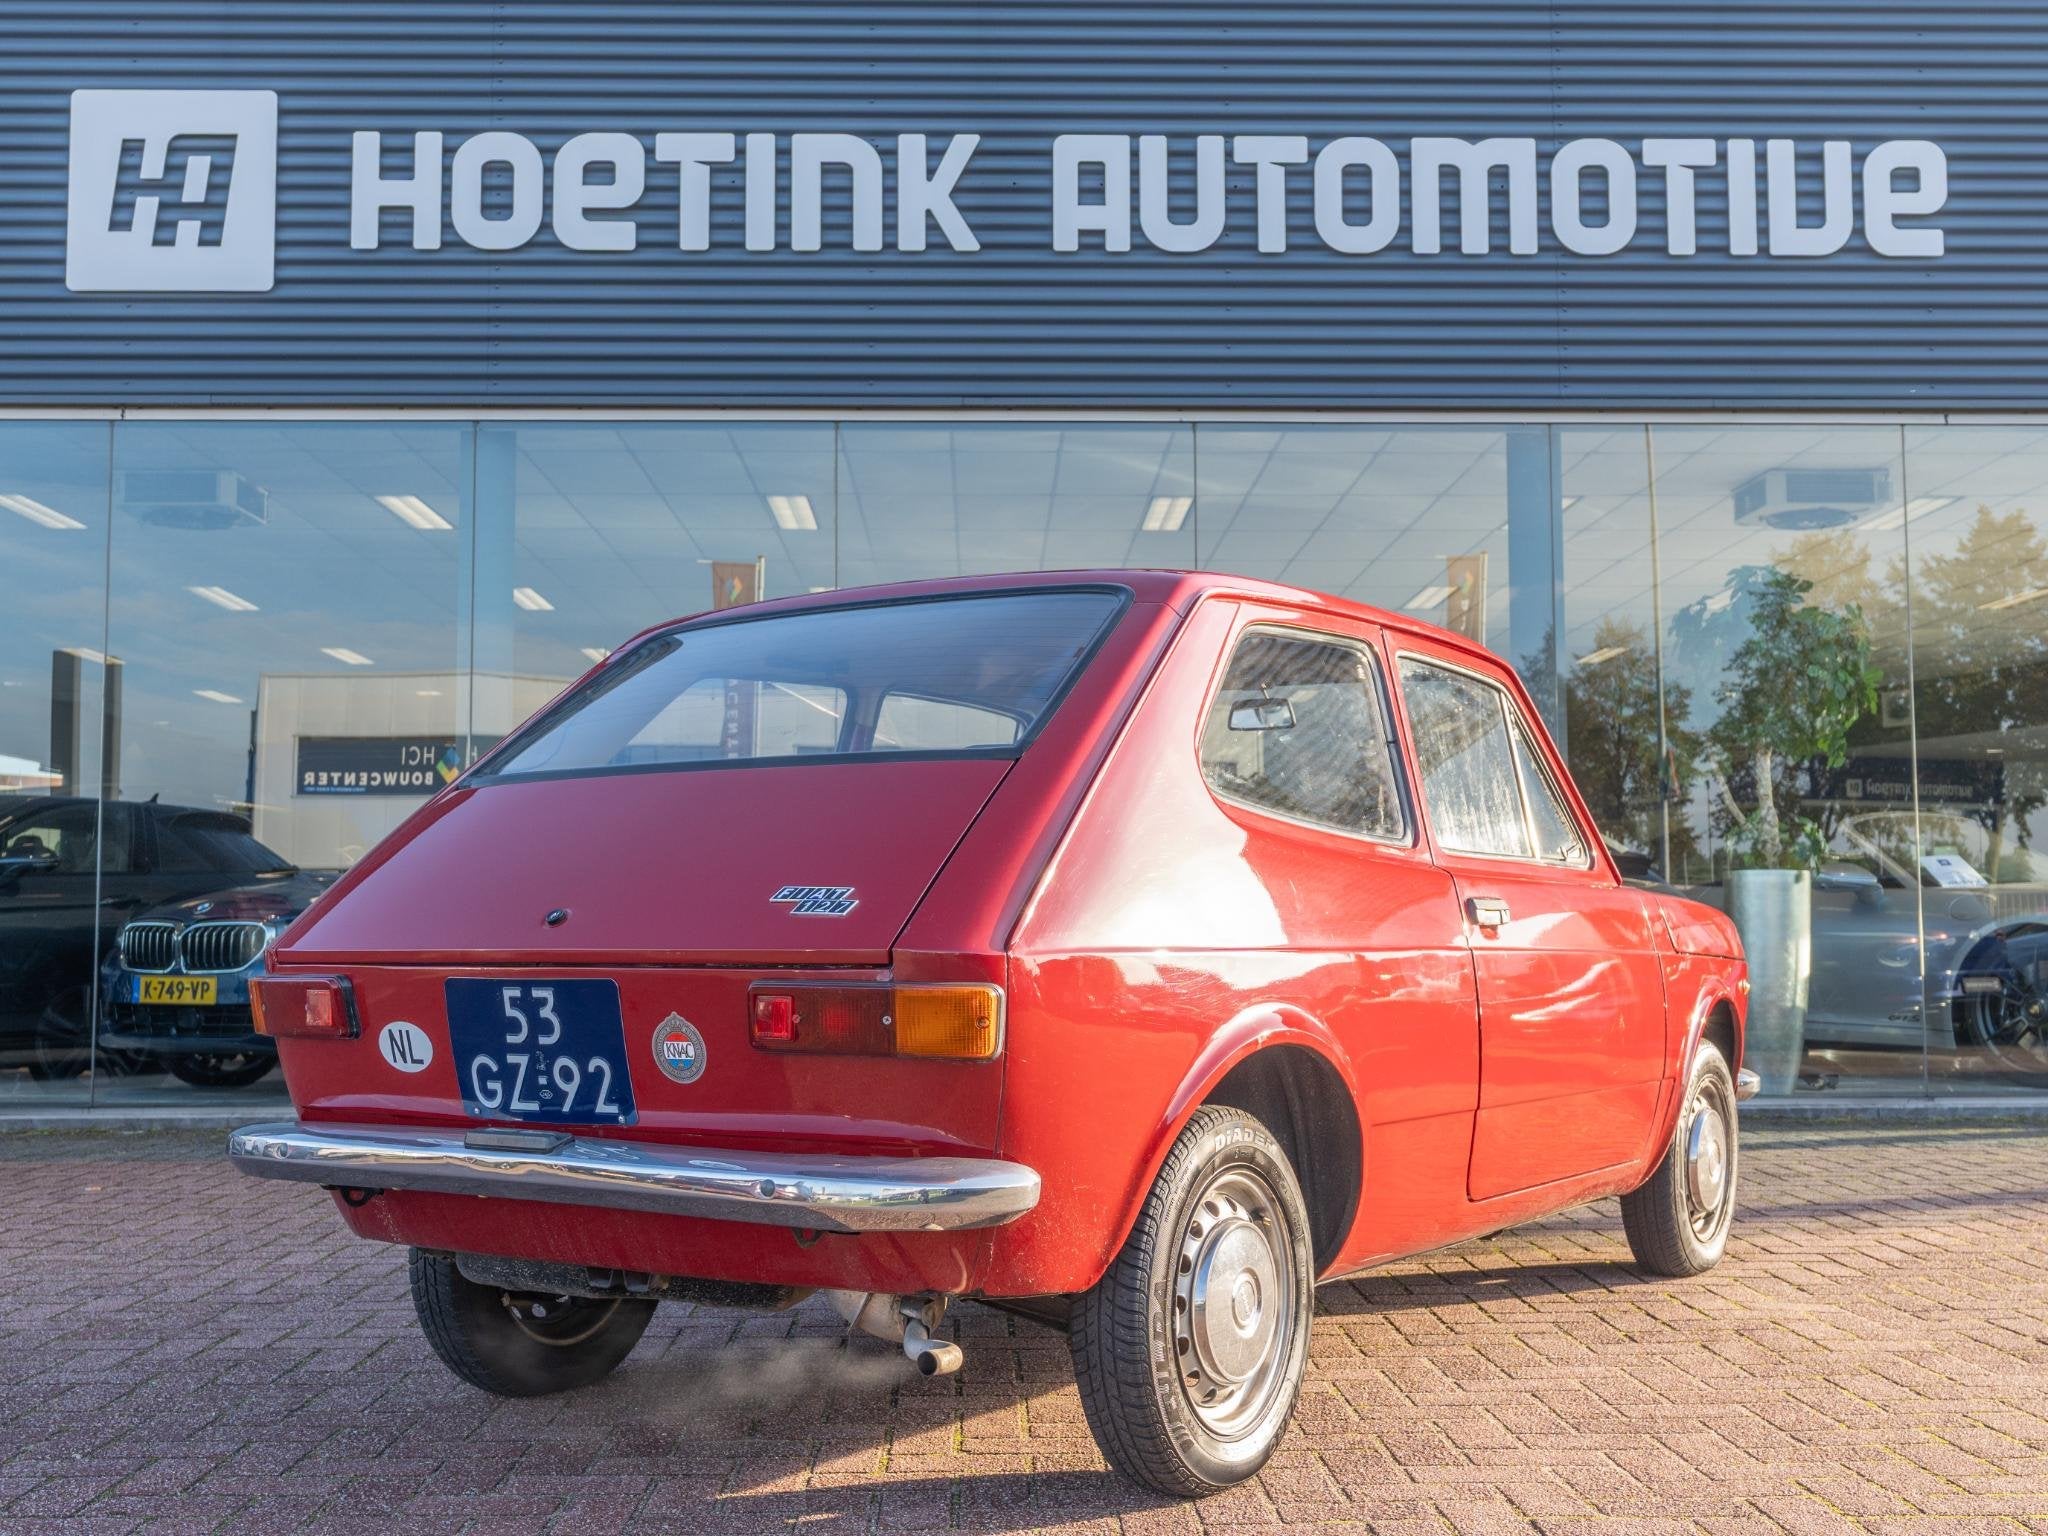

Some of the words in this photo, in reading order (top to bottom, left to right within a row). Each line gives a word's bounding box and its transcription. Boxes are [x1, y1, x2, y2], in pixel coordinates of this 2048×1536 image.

[350, 130, 981, 252] HOETINK
[1052, 133, 1949, 257] AUTOMOTIVE
[777, 887, 848, 899] FIAT
[800, 900, 850, 912] 127
[144, 980, 210, 1000] K-749-VP
[502, 986, 561, 1045] 53
[387, 1028, 425, 1065] NL
[665, 1042, 694, 1058] KNAC
[471, 1053, 619, 1113] GZ-92
